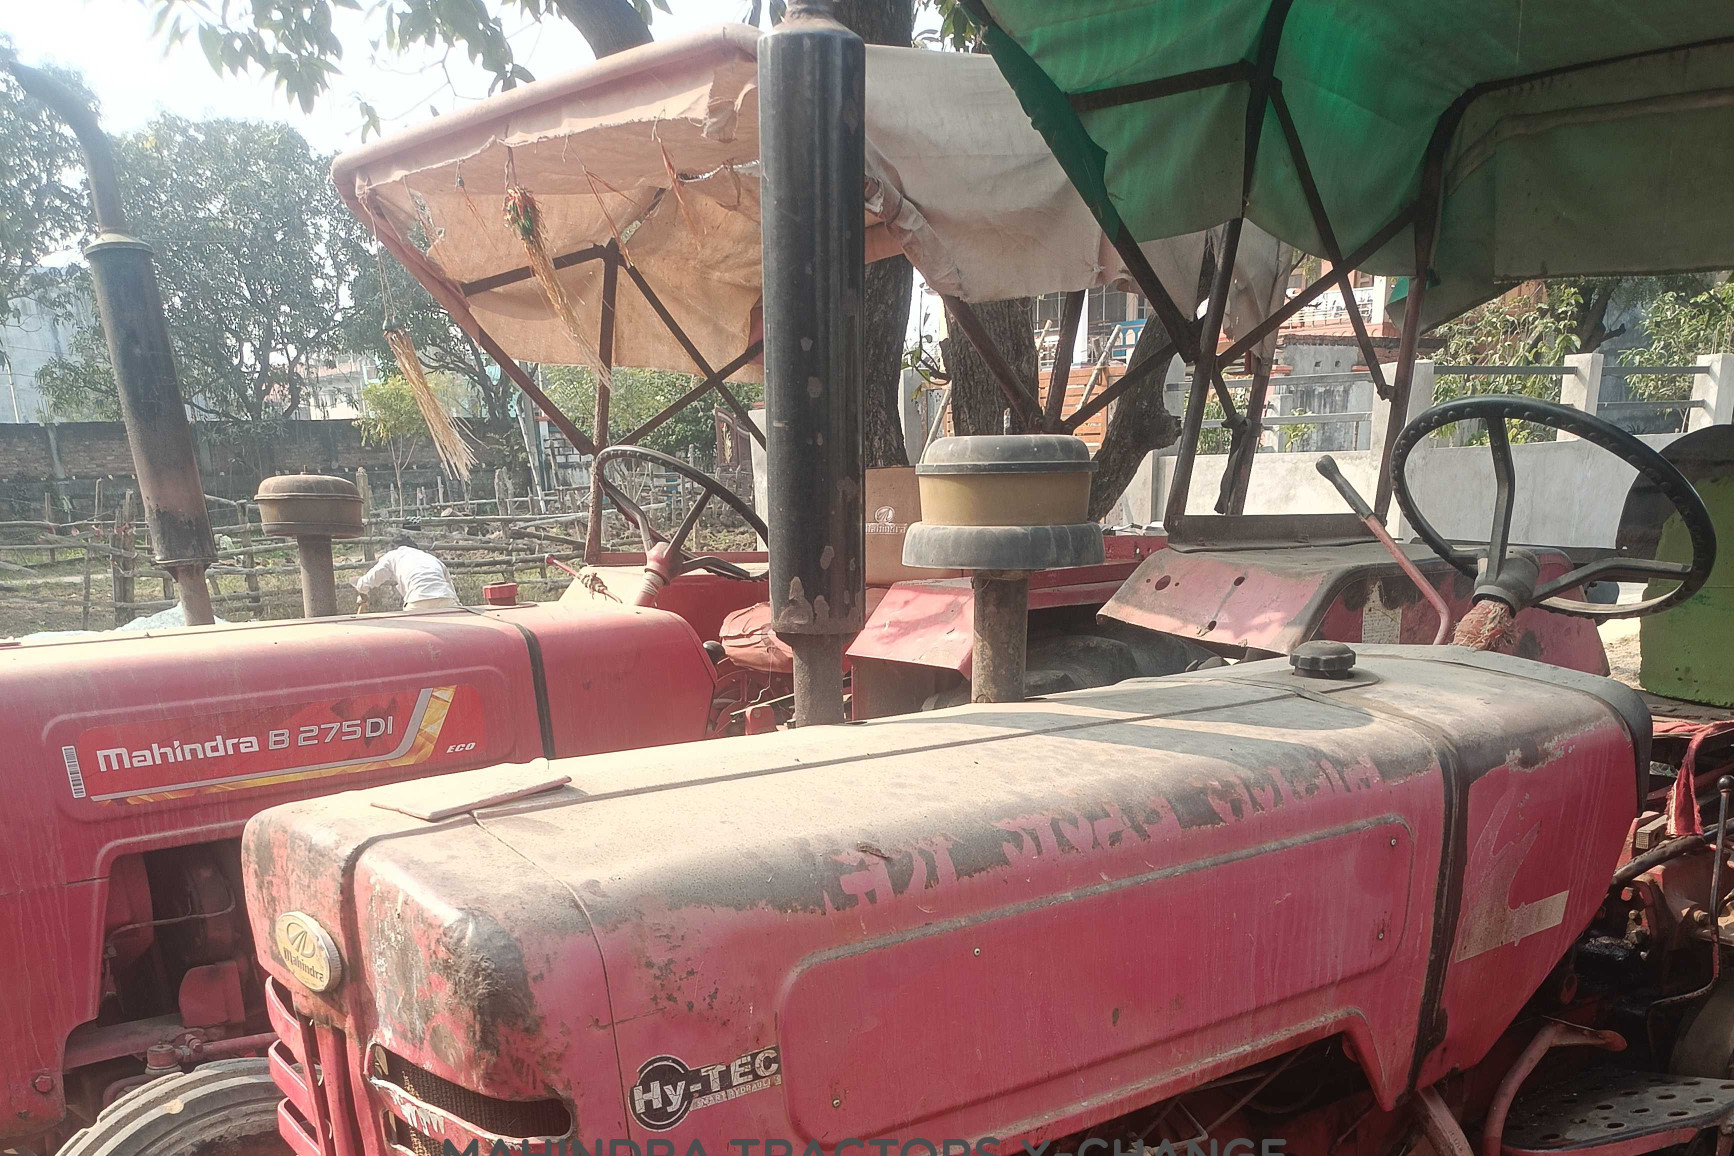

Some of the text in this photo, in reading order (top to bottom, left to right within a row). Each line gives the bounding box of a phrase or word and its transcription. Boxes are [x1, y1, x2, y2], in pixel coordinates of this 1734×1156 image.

[97, 734, 260, 772] Mahindra
[268, 729, 290, 750] B
[446, 742, 476, 754] ECO
[633, 1050, 779, 1114] Hy-TEC
[727, 1075, 781, 1100] HYDRAULIS
